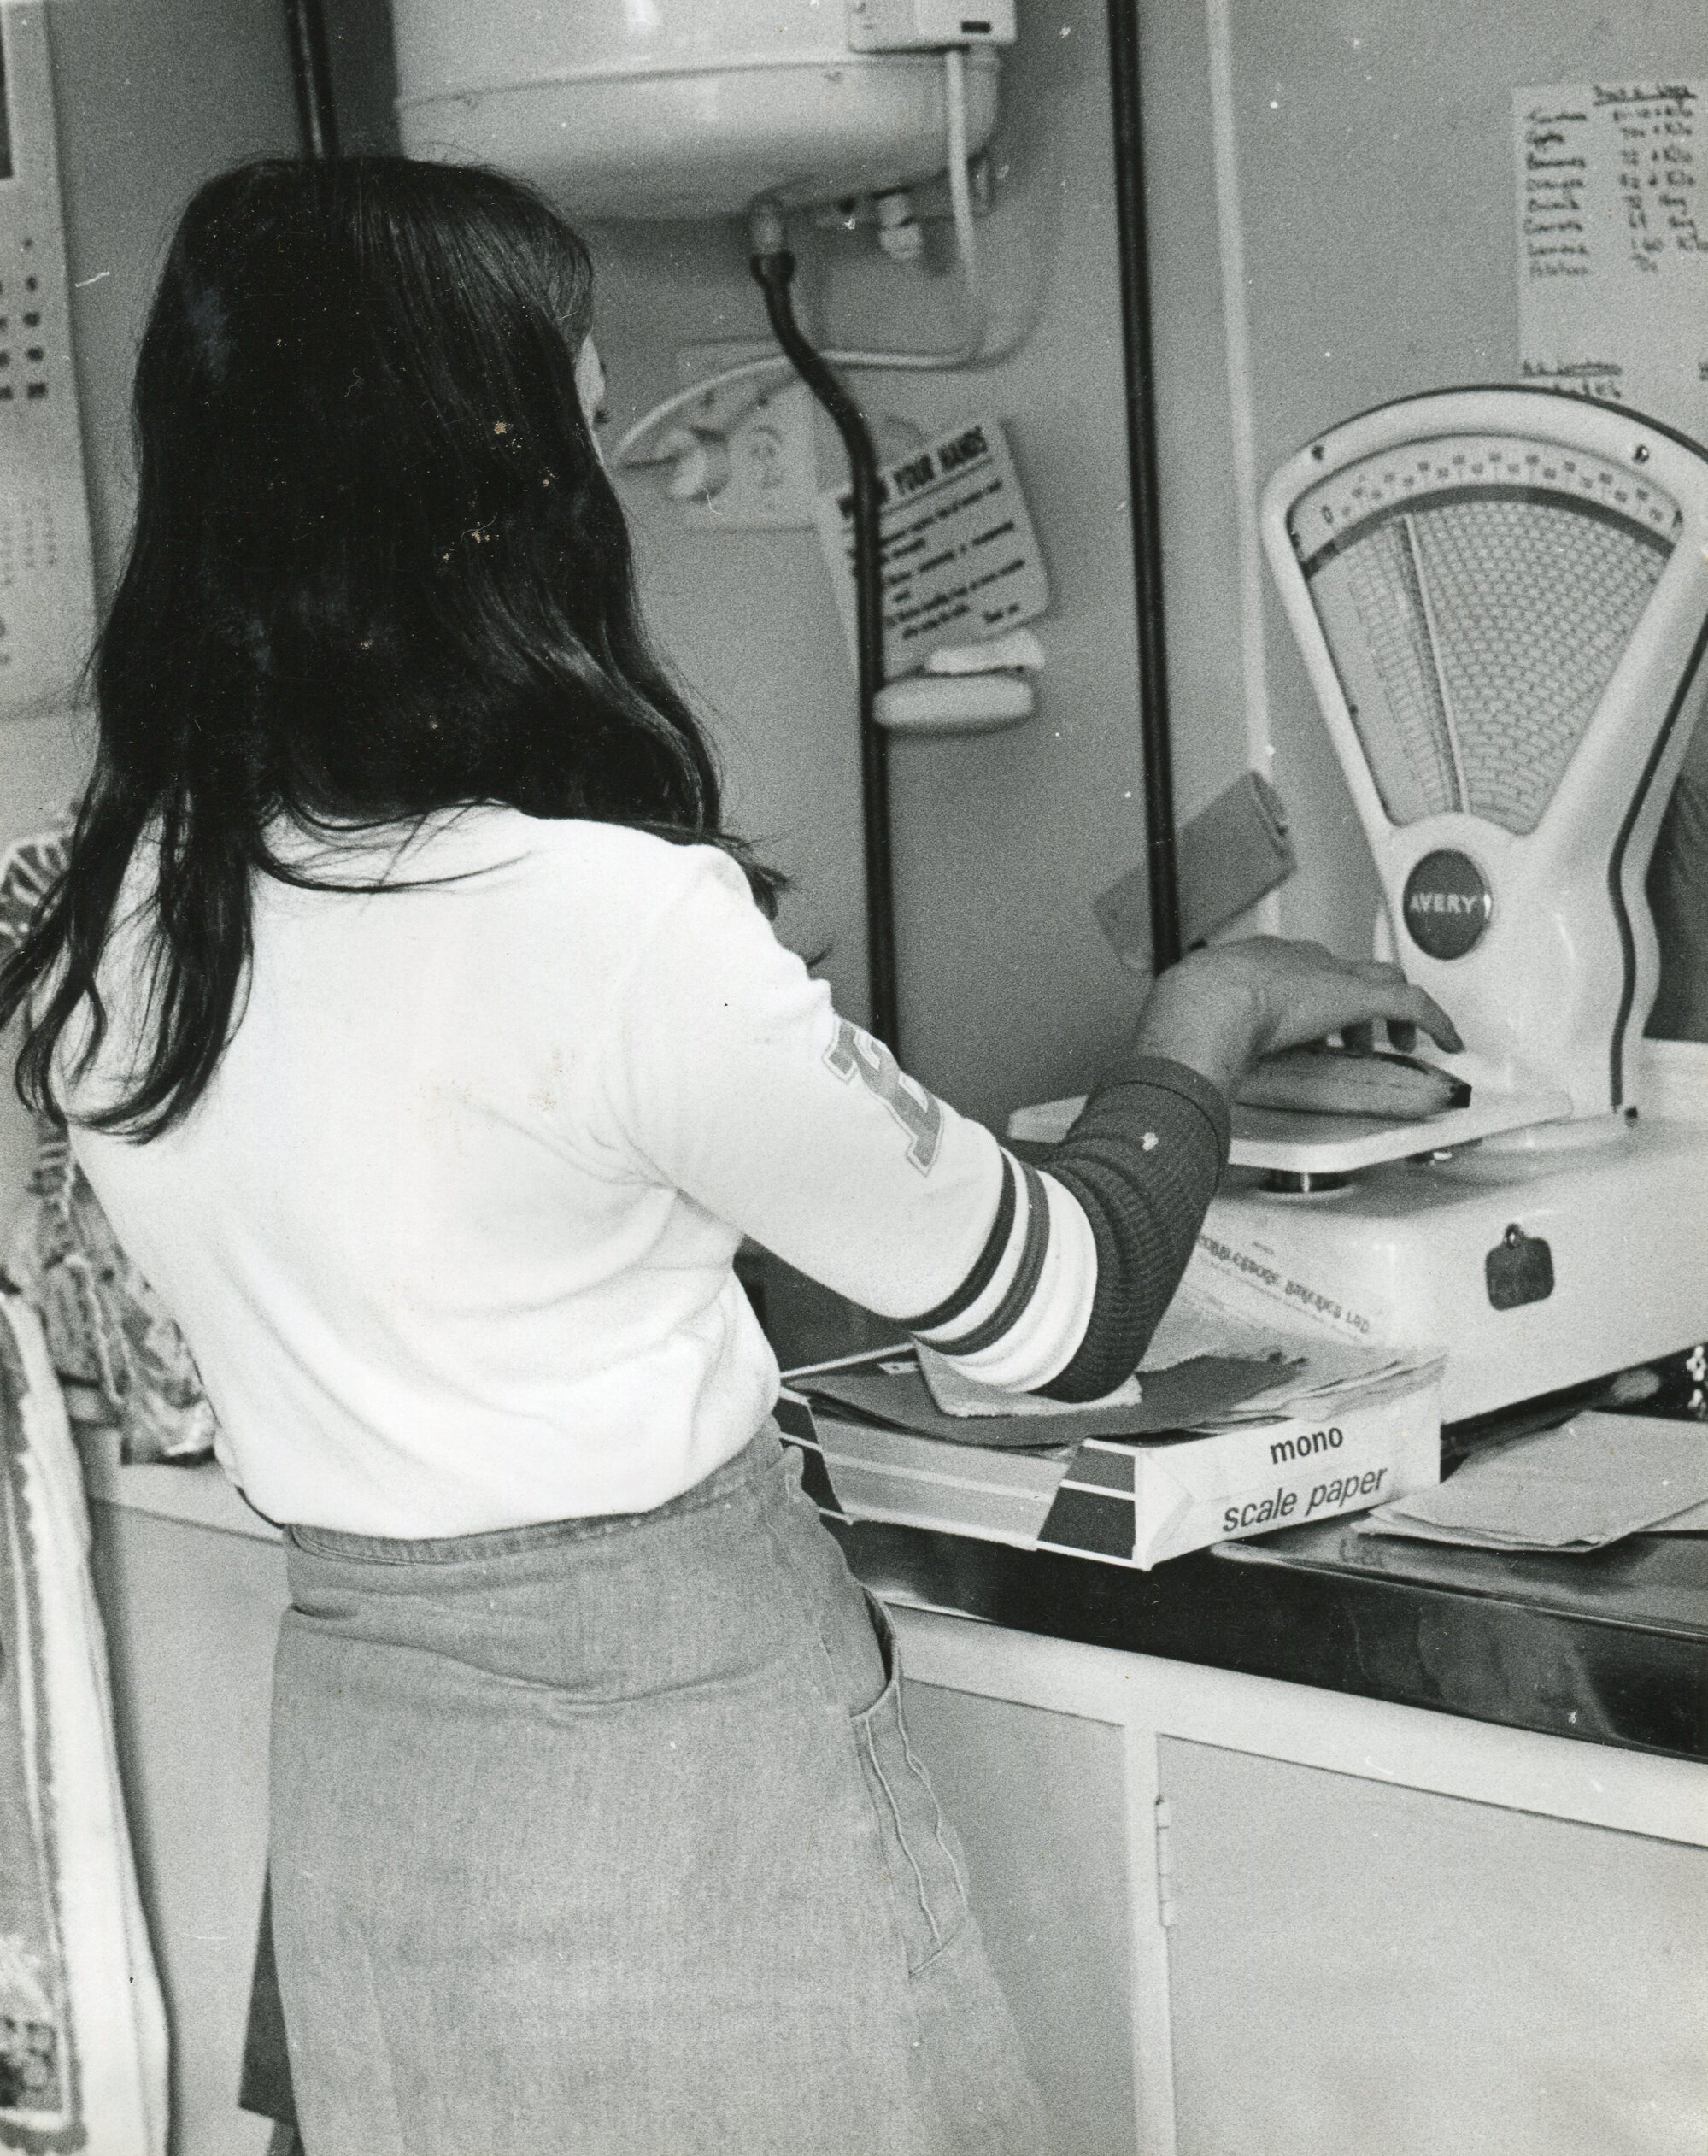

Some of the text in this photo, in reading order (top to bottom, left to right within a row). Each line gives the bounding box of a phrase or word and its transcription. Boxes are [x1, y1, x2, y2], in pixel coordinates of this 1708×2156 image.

[1410, 892, 1478, 914] AVERY
[1270, 1427, 1344, 1465] mono
[1222, 1467, 1388, 1533] scale paper
